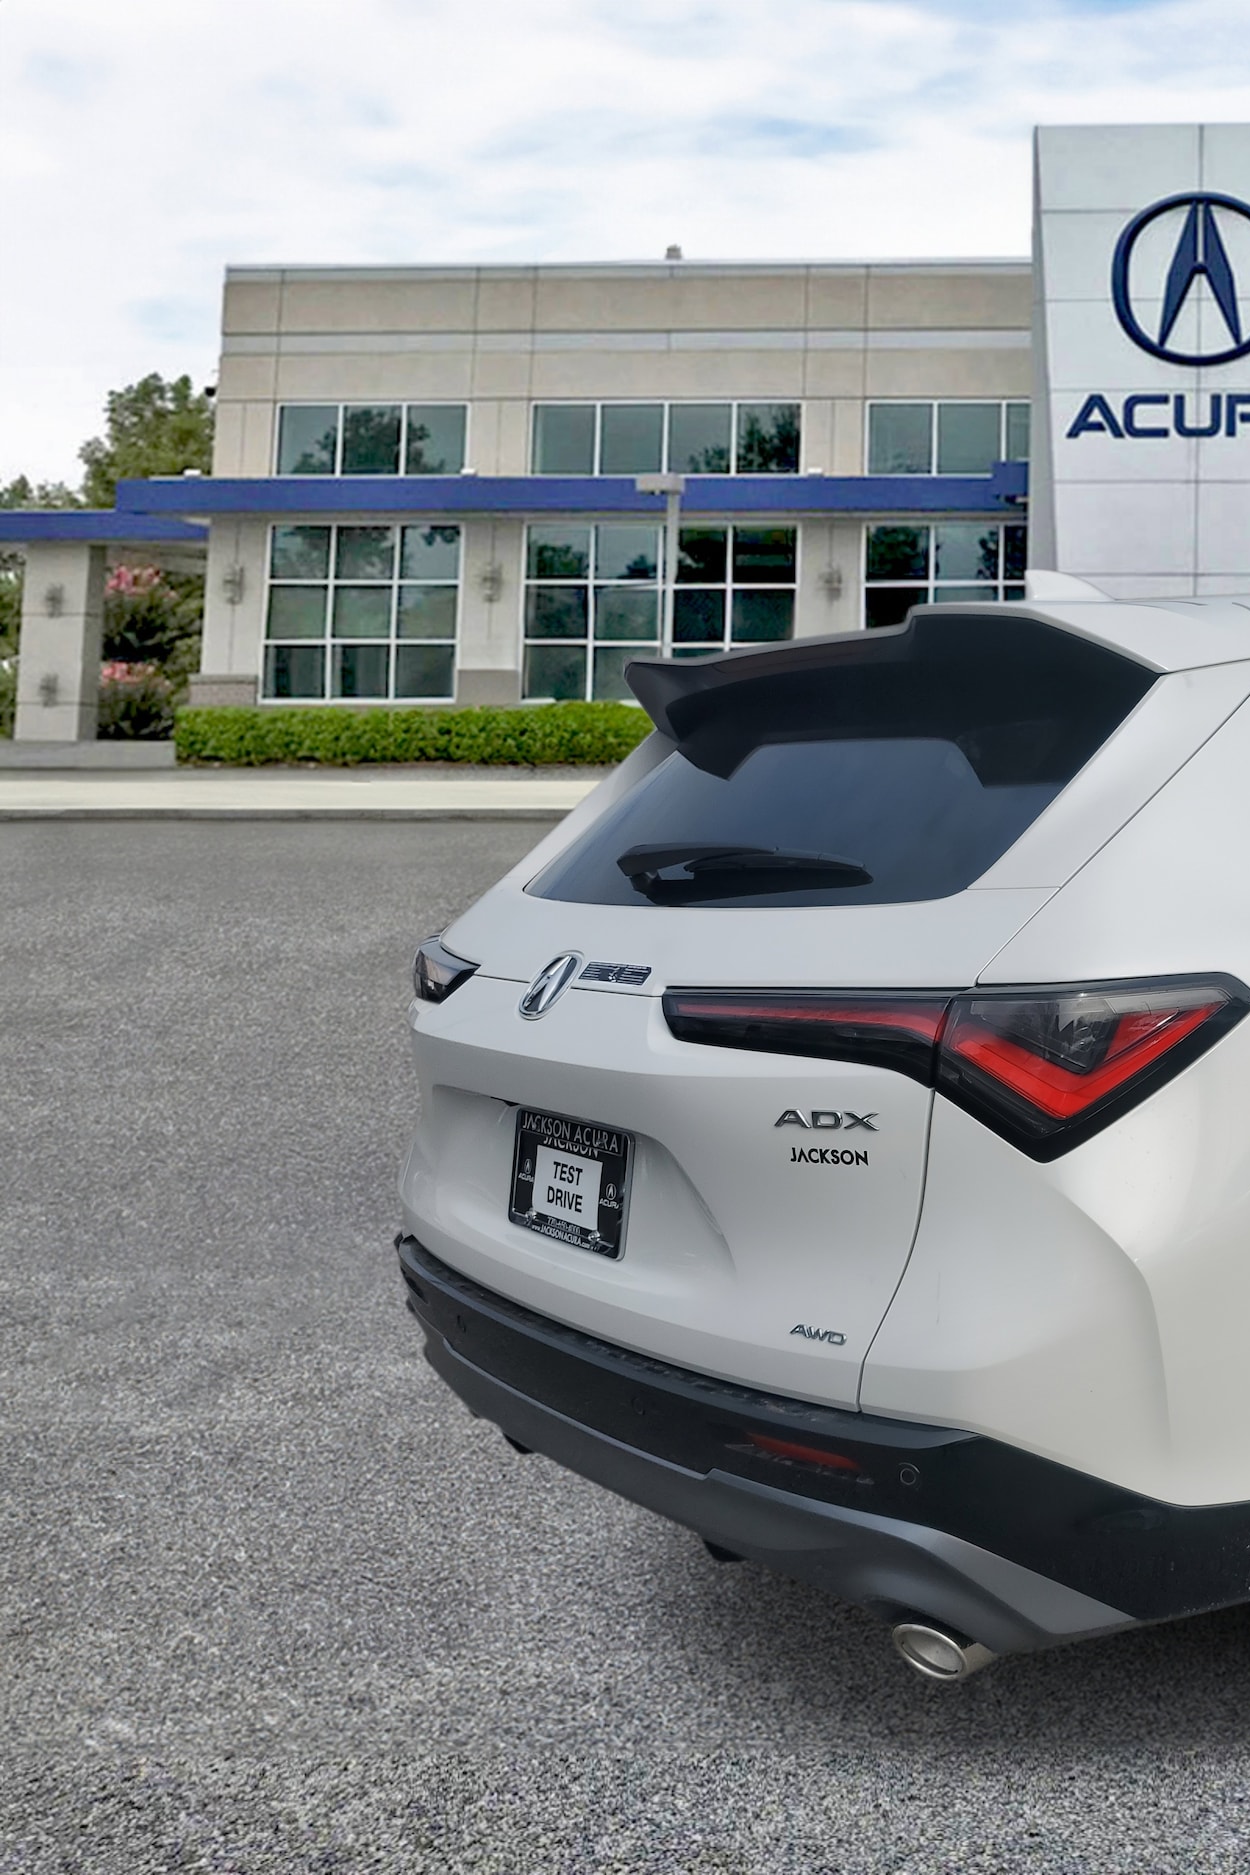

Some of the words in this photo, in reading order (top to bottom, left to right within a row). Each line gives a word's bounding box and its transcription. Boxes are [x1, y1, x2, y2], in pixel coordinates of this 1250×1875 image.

[774, 1108, 880, 1132] ADX
[522, 1112, 571, 1141] JACKSON
[574, 1126, 619, 1153] ACURA
[790, 1147, 869, 1166] JACKSON
[553, 1161, 583, 1186] TEST
[547, 1185, 583, 1213] DRIVE
[790, 1324, 847, 1346] AWD
